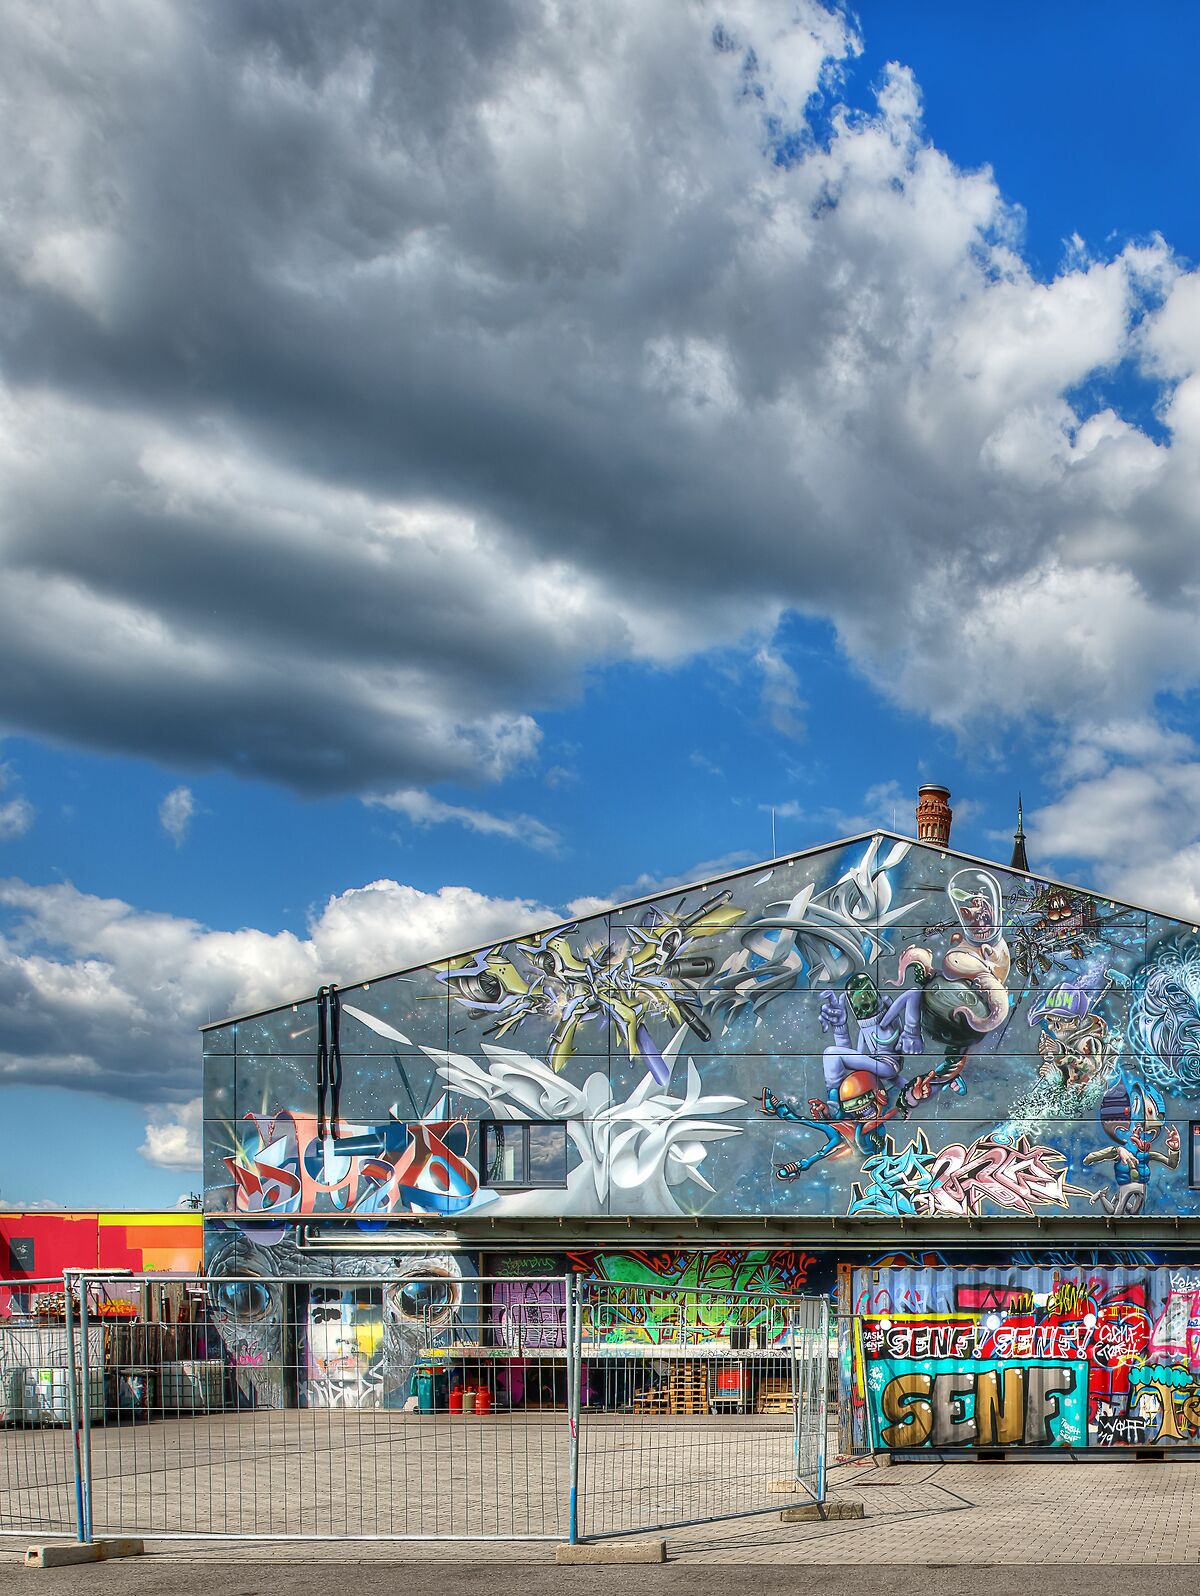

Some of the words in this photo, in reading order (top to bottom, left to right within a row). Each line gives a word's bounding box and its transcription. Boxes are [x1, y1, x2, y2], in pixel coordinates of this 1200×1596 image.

[887, 1325, 988, 1360] SENF!
[992, 1325, 1095, 1360] SENF!
[881, 1366, 1077, 1447] SENF
